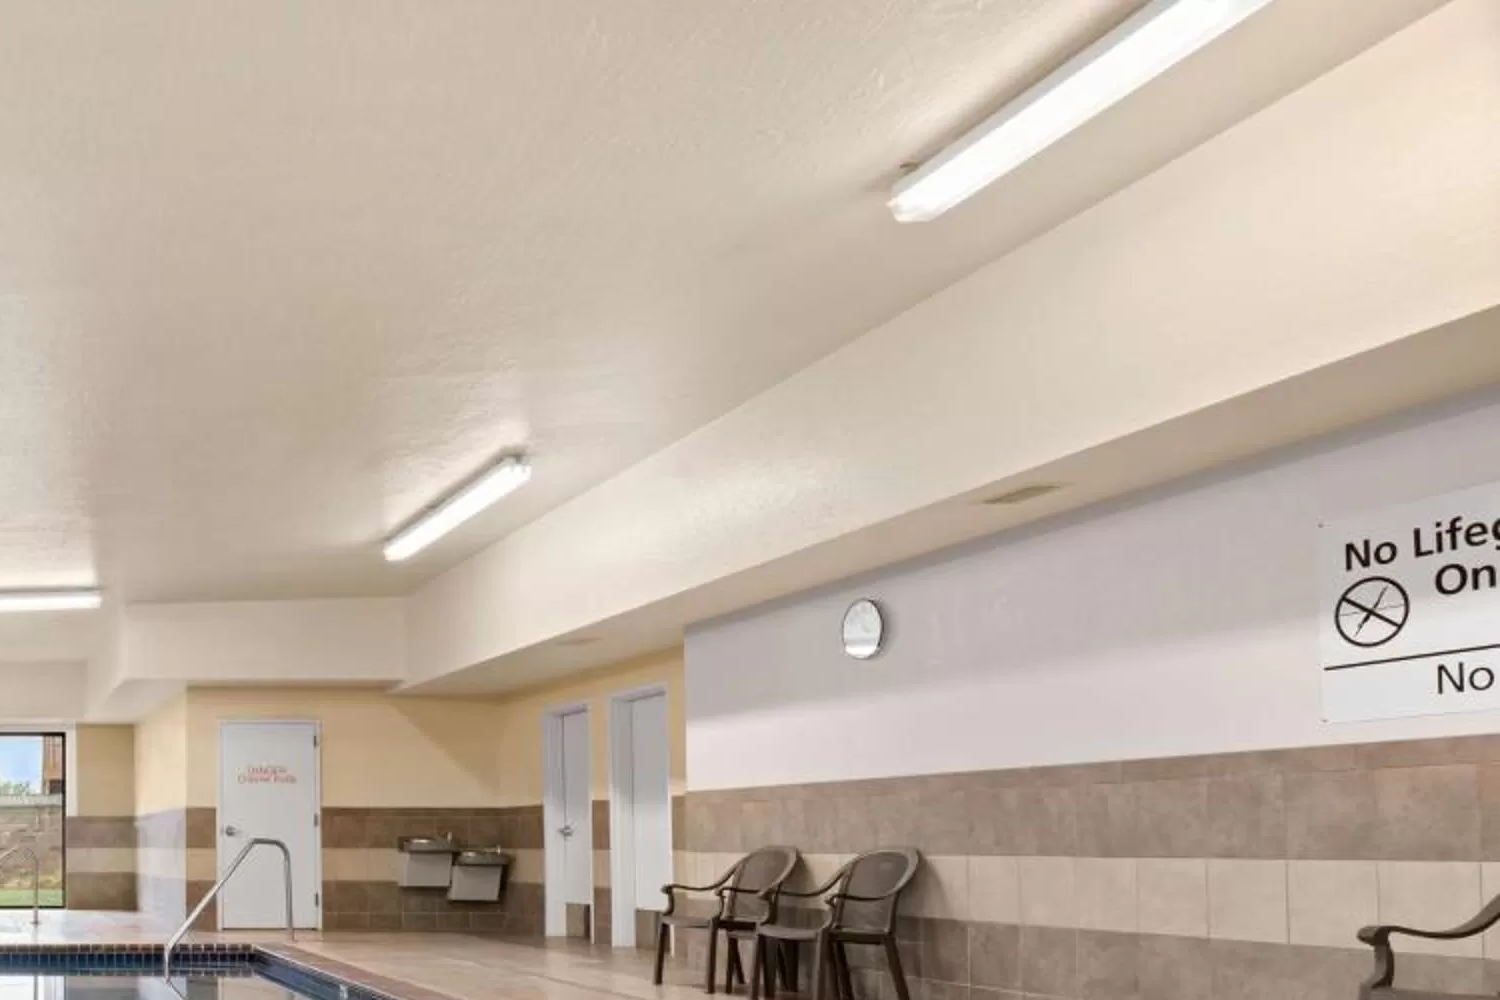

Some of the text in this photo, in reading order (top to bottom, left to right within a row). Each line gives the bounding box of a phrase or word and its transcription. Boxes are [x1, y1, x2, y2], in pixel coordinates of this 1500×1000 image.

[1345, 539, 1398, 572] No
[1435, 563, 1497, 595] On
[1438, 661, 1495, 695] No
